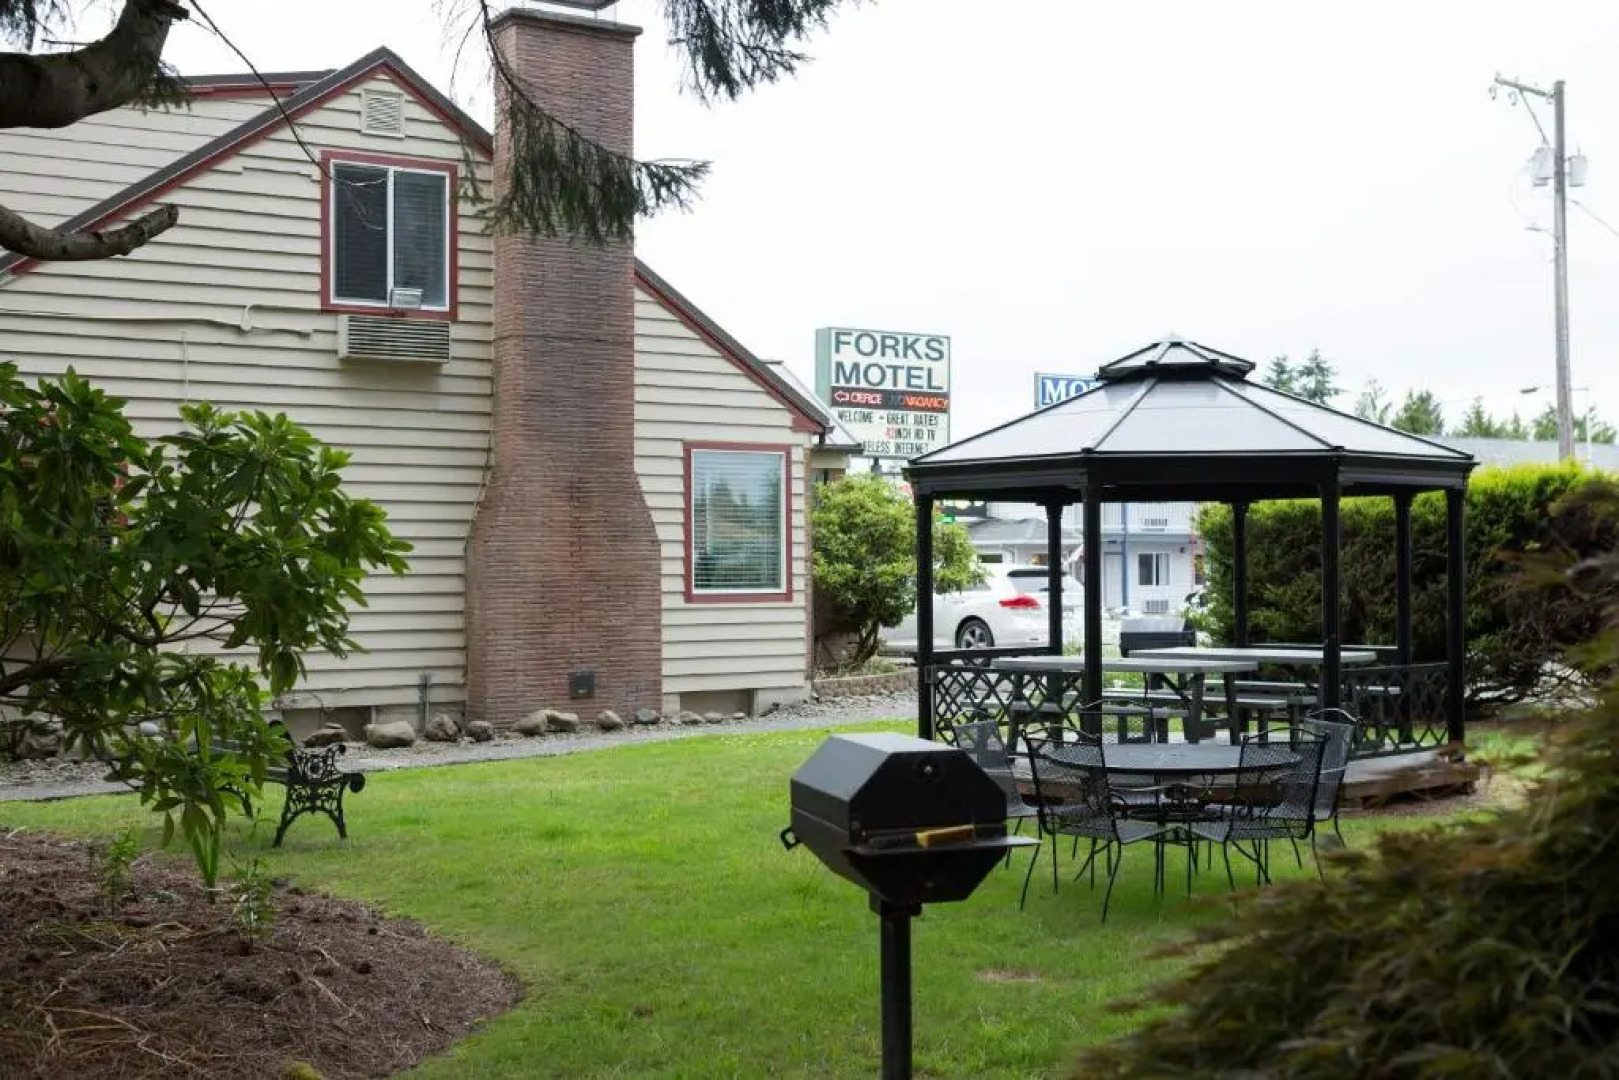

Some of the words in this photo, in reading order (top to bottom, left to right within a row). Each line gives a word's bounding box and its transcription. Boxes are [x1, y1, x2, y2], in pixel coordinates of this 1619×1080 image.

[834, 331, 945, 362] FORKS
[834, 361, 943, 390] MOTEL
[850, 391, 882, 404] OFFICE
[905, 395, 948, 408] VACANCY
[838, 411, 873, 423] WELCOME
[887, 411, 909, 425] GREAT
[914, 413, 939, 426] RATES
[895, 442, 929, 455] INTERNET
